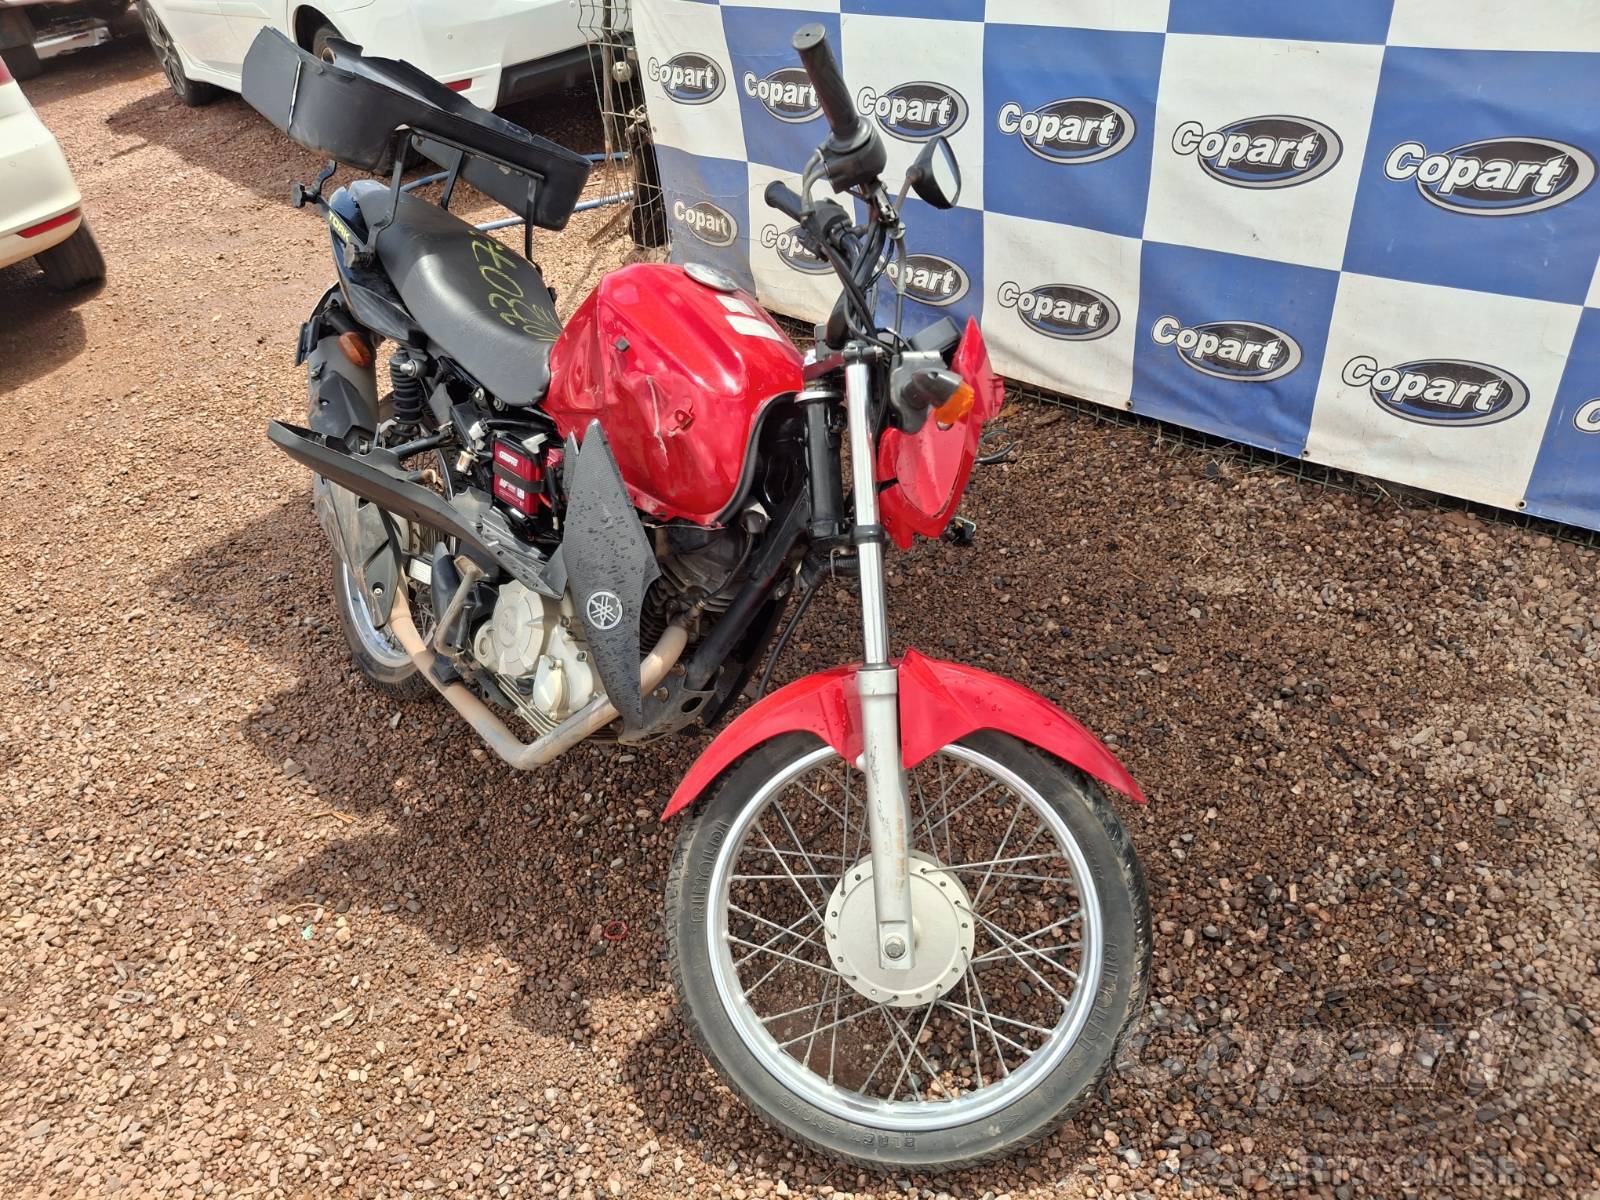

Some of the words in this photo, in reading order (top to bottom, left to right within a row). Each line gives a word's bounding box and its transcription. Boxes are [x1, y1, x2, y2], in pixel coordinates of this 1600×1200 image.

[648, 57, 716, 90] Copart
[743, 71, 818, 107] Copart
[858, 87, 953, 127] Copart
[999, 102, 1117, 146] Copart
[1172, 121, 1320, 169] Copart
[1384, 142, 1570, 195] Copart
[673, 200, 730, 241] Copart
[997, 281, 1102, 328] Copart
[1152, 315, 1284, 370] Copart
[1341, 354, 1505, 413] Copart
